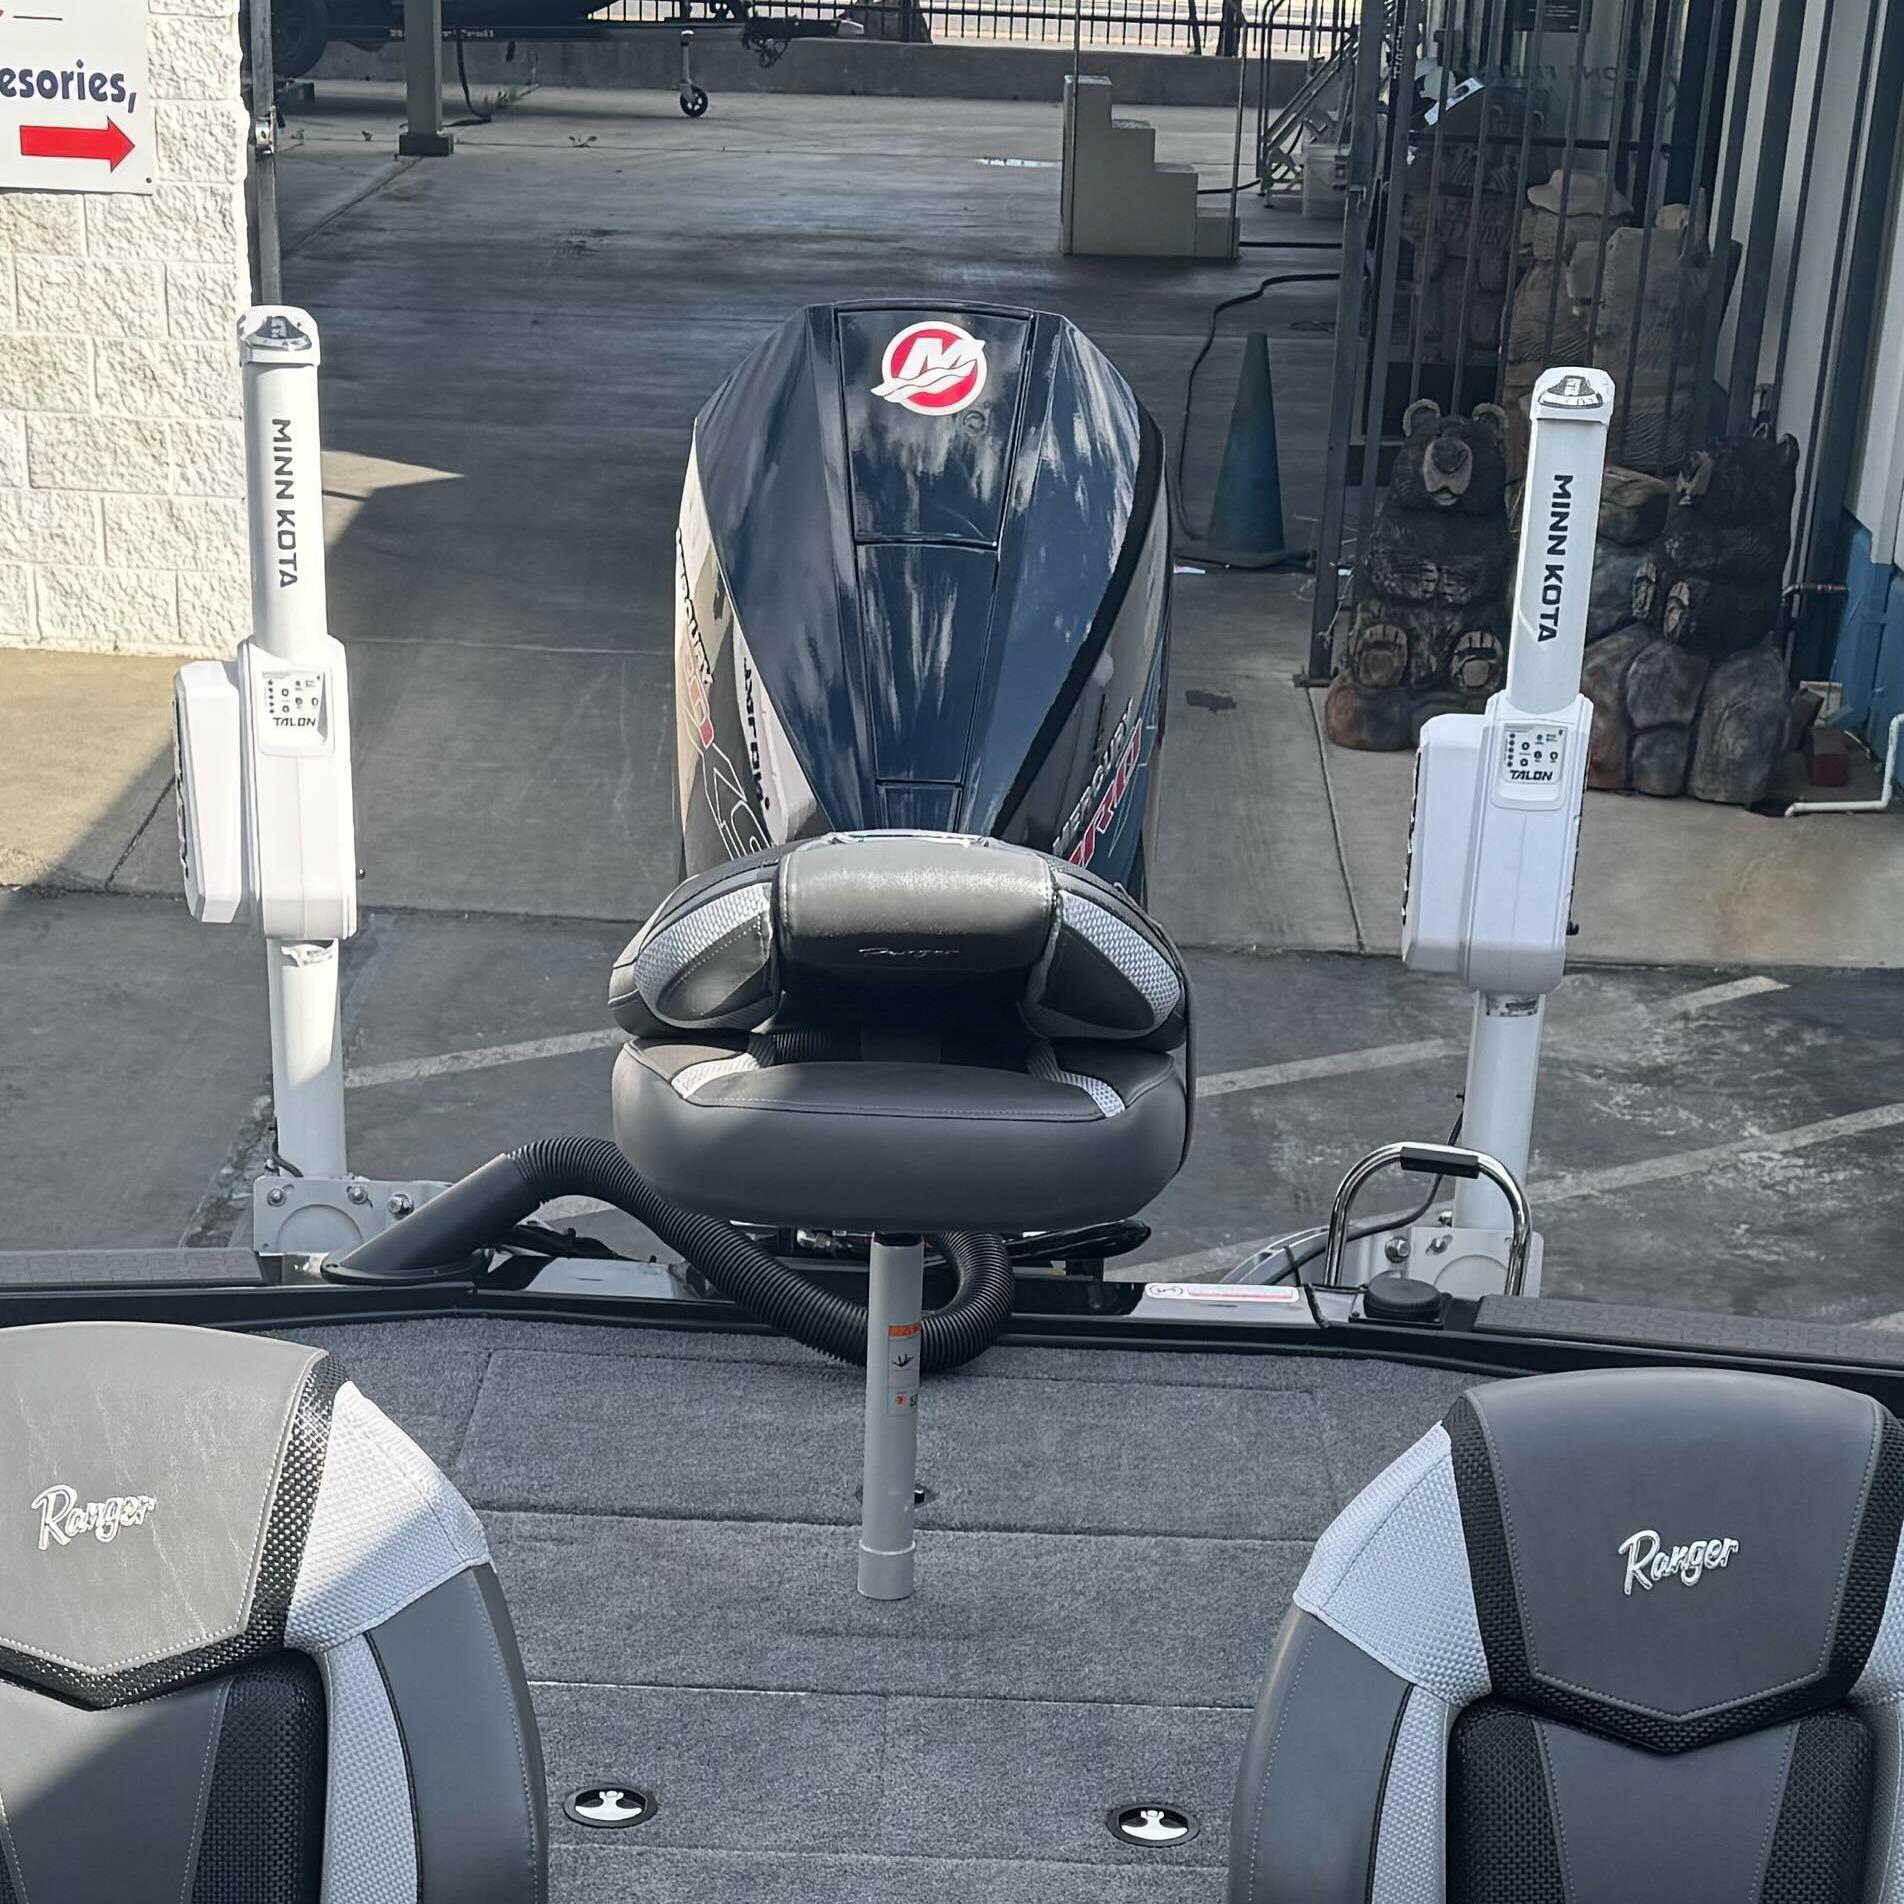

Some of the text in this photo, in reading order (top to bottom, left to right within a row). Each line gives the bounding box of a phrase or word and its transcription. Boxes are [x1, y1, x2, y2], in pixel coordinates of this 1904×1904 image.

[272, 418, 298, 589] MINN KOTA
[1537, 474, 1574, 644] MINN KOTA
[272, 717, 316, 727] TALON
[1509, 769, 1553, 781] TALON
[32, 1484, 157, 1551] Ranger
[1618, 1529, 1739, 1595] Ranger
